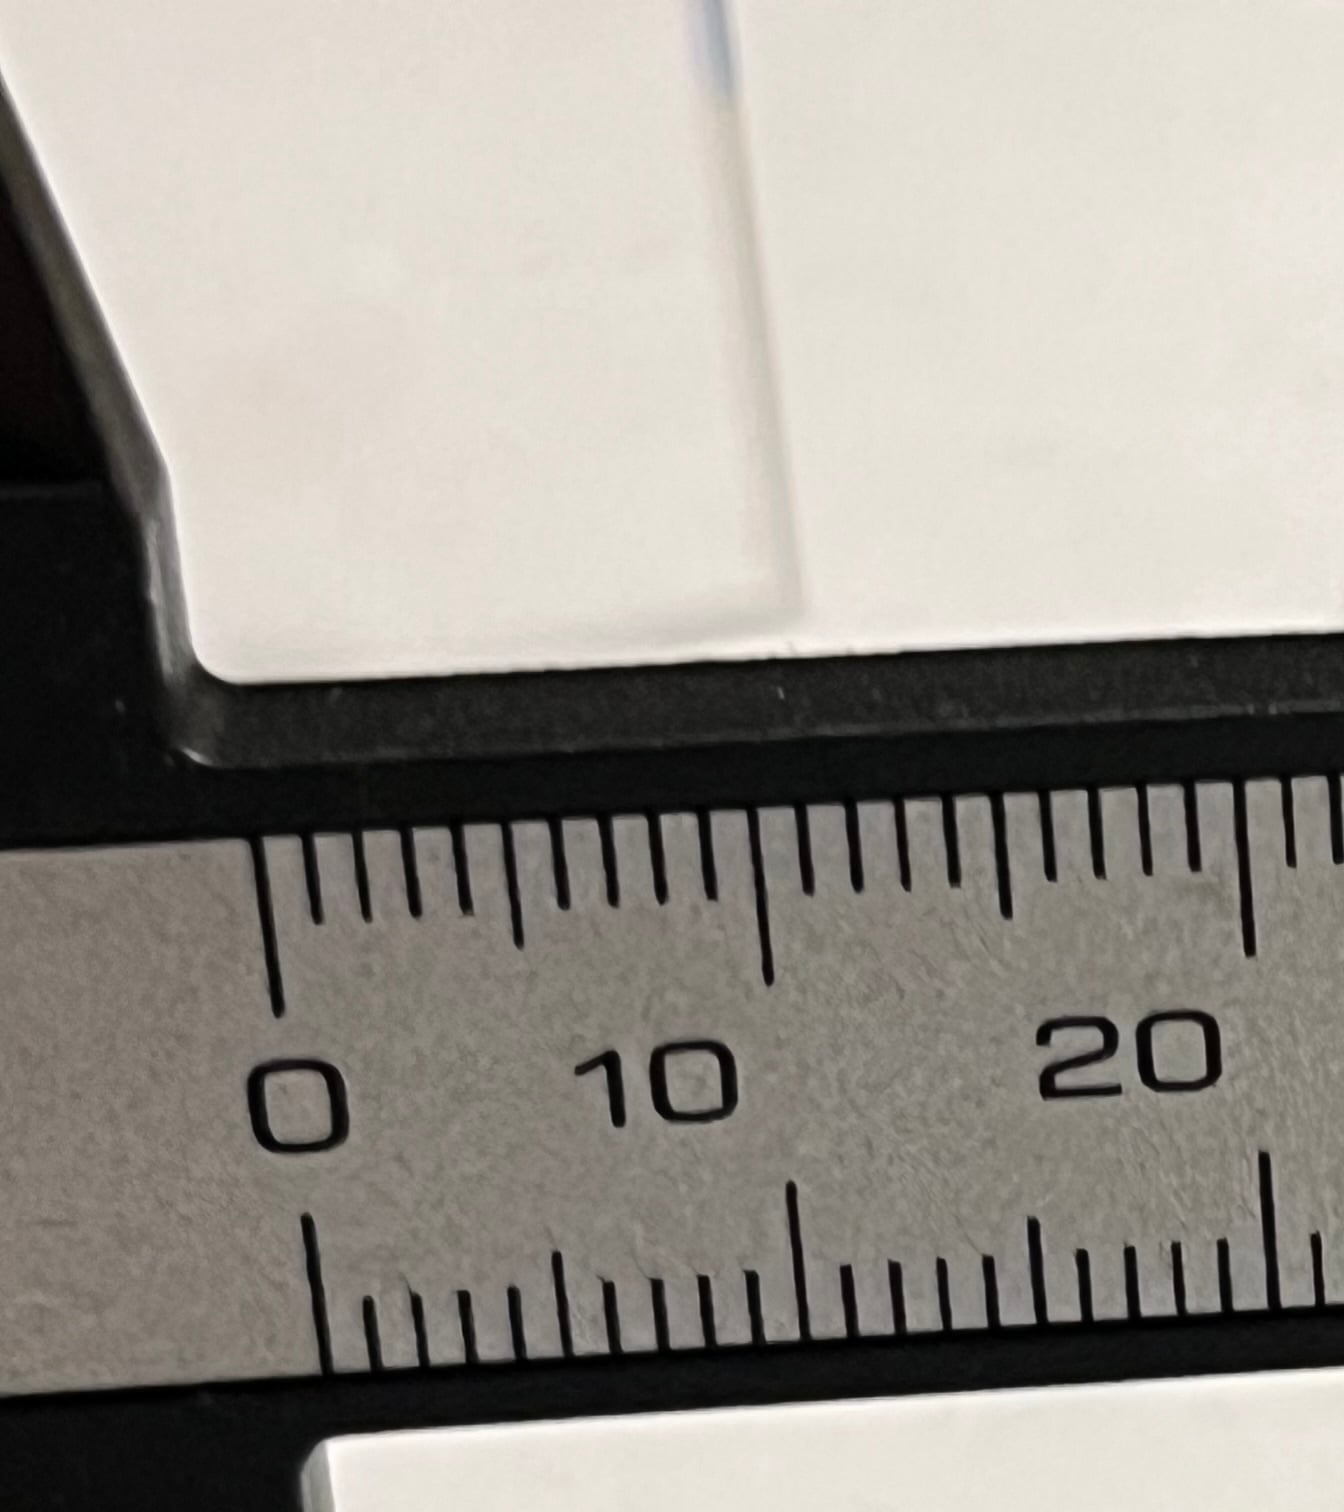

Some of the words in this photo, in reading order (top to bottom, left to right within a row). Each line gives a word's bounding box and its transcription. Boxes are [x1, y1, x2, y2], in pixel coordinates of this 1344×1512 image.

[246, 1057, 350, 1154] 0
[574, 1038, 739, 1129] 10
[1035, 1009, 1222, 1101] 20
